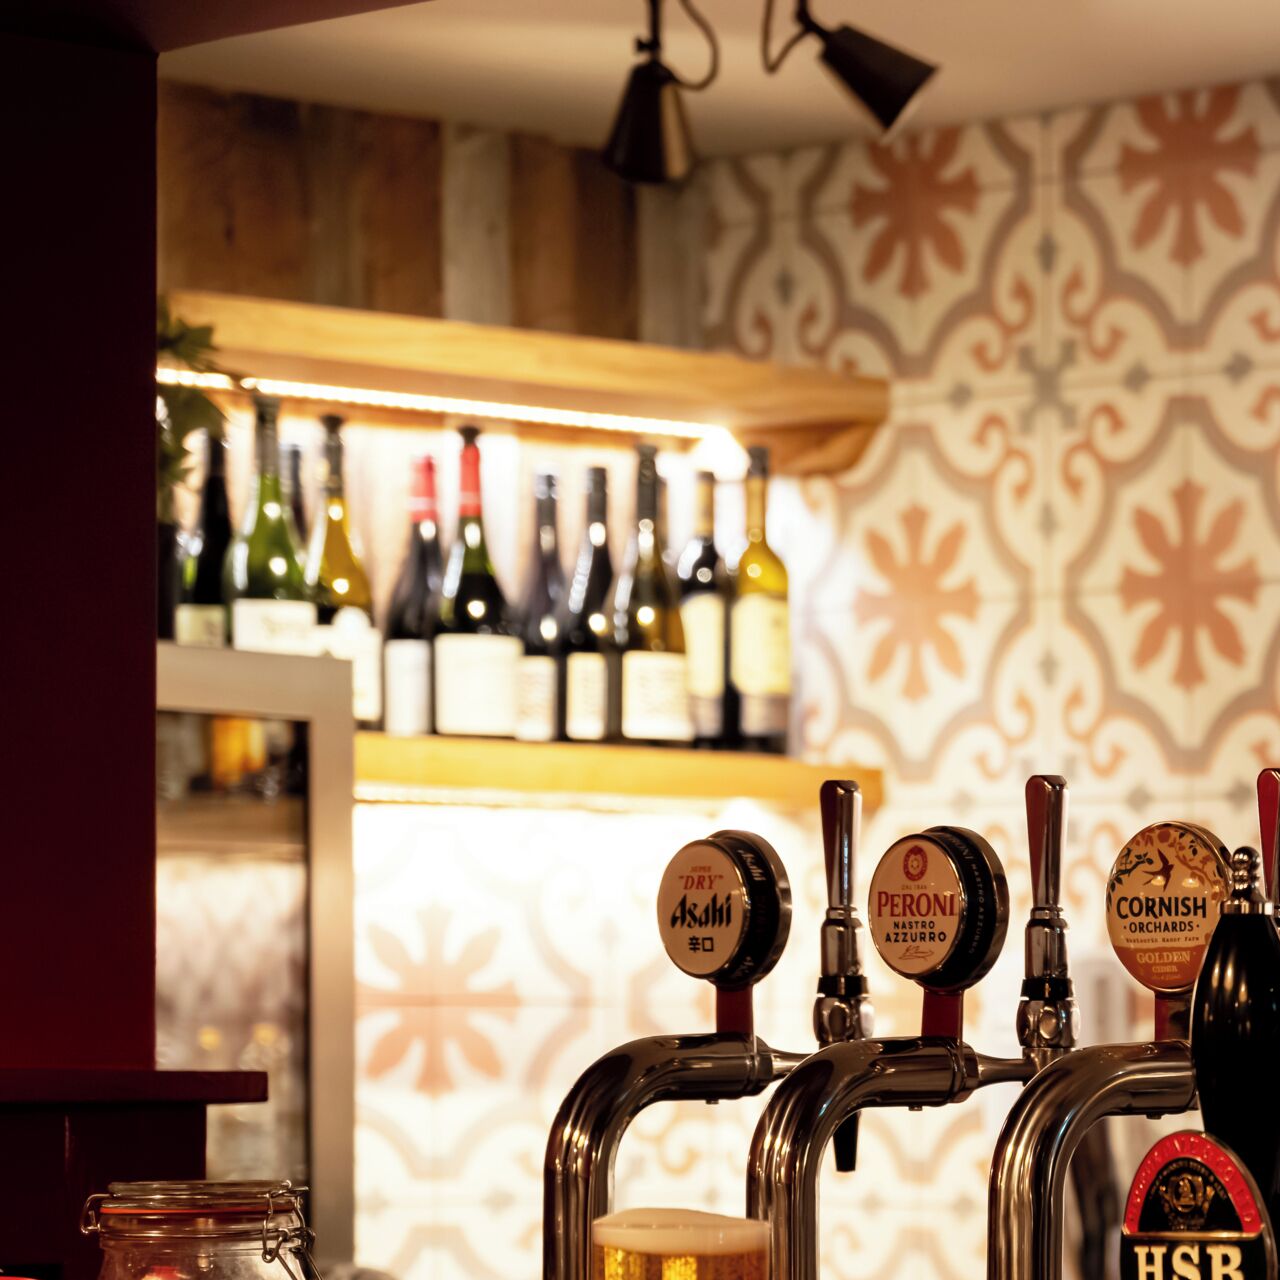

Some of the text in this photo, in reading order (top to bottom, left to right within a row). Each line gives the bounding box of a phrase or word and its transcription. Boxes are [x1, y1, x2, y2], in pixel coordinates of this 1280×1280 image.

[670, 893, 732, 929] Asahi
[877, 891, 958, 917] PERONI
[1116, 896, 1207, 919] CORNISH
[893, 920, 935, 930] NASTRO
[1129, 921, 1194, 933] ORCHARDS
[884, 931, 947, 942] AZZURRO
[1136, 950, 1192, 964] GOLDEN
